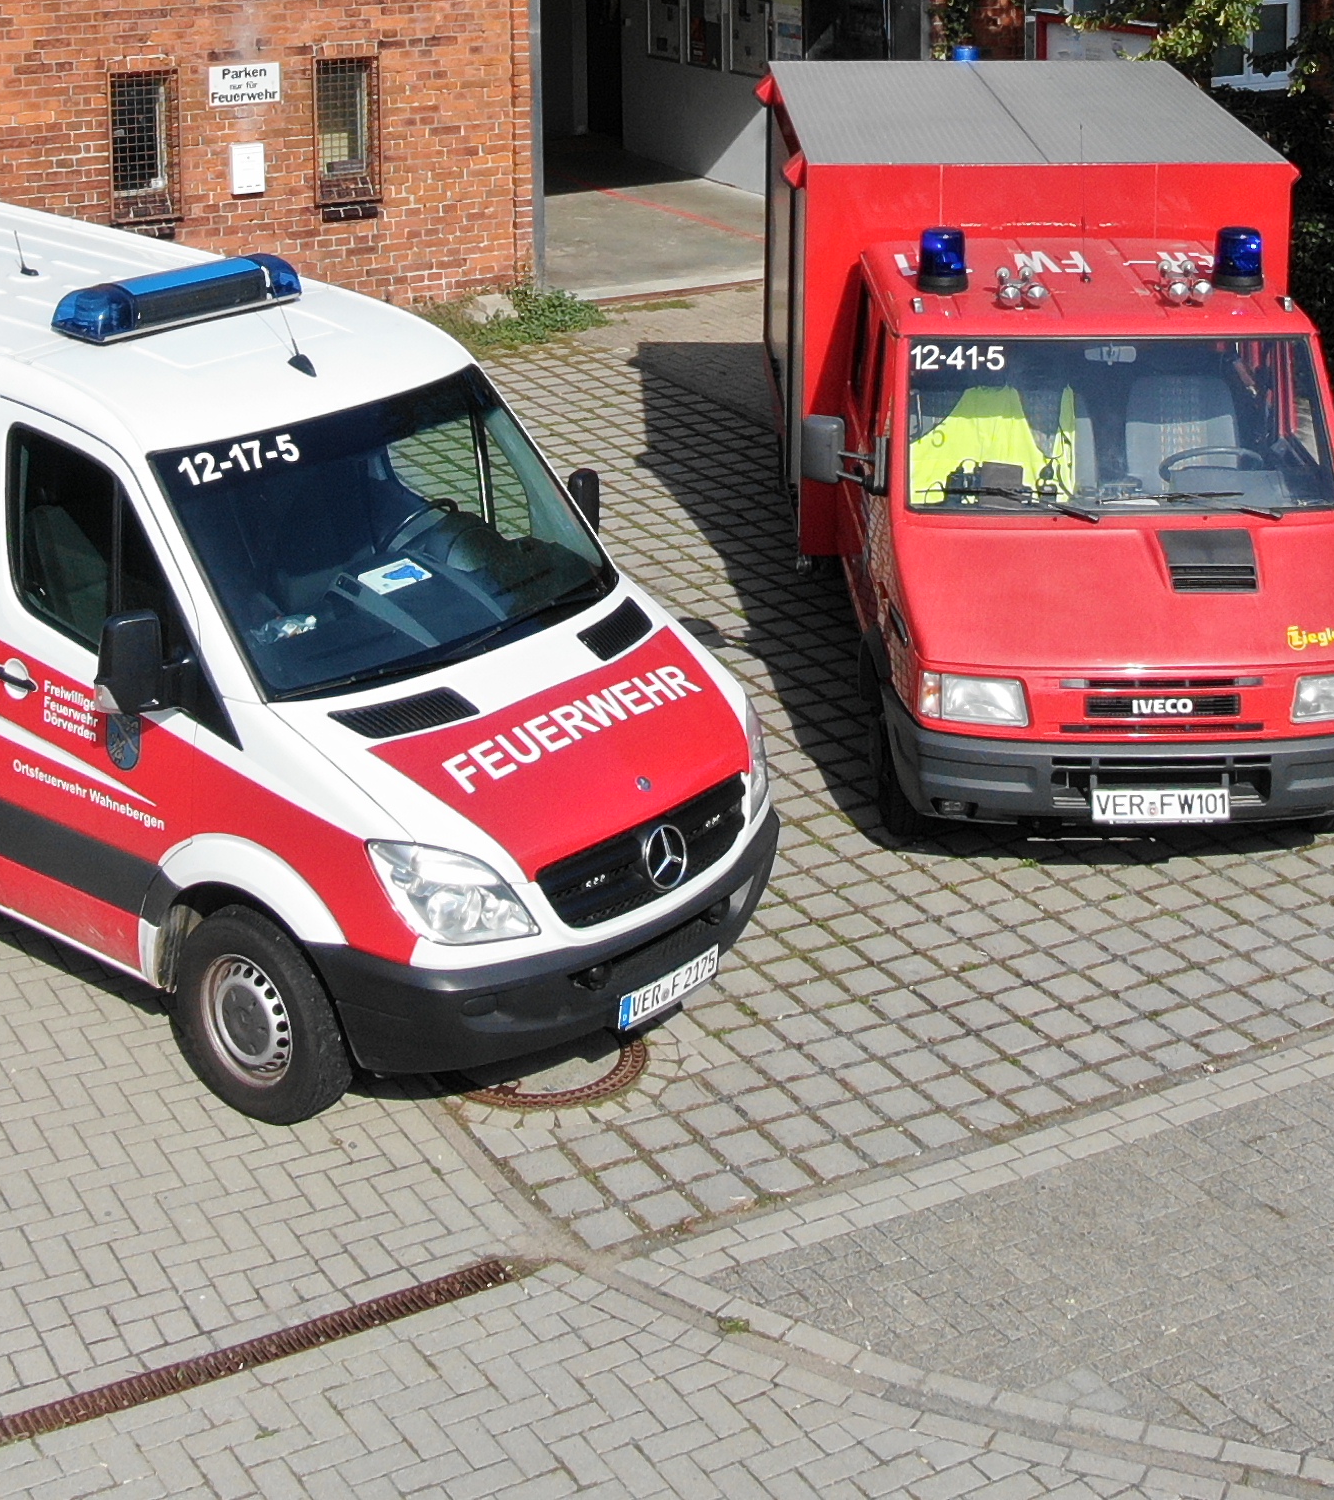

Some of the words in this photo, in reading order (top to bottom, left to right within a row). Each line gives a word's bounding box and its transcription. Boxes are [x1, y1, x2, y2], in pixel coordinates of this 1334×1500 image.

[222, 67, 267, 79] Parken
[211, 89, 278, 103] Feuerwehr
[910, 345, 1005, 371] 12-41-5
[177, 433, 300, 486] 12-17-5
[43, 695, 99, 728] Feuerwehr
[1131, 698, 1193, 714] IVECO
[43, 710, 97, 742] Dörverden
[441, 665, 702, 794] FEUERWEHR
[12, 759, 88, 798] Ortsfeuerwehr
[89, 788, 165, 831] Wahnebergen
[1096, 794, 1144, 816] VER
[632, 983, 661, 1017] VER
[671, 972, 681, 997] F
[683, 950, 716, 990] 2175
